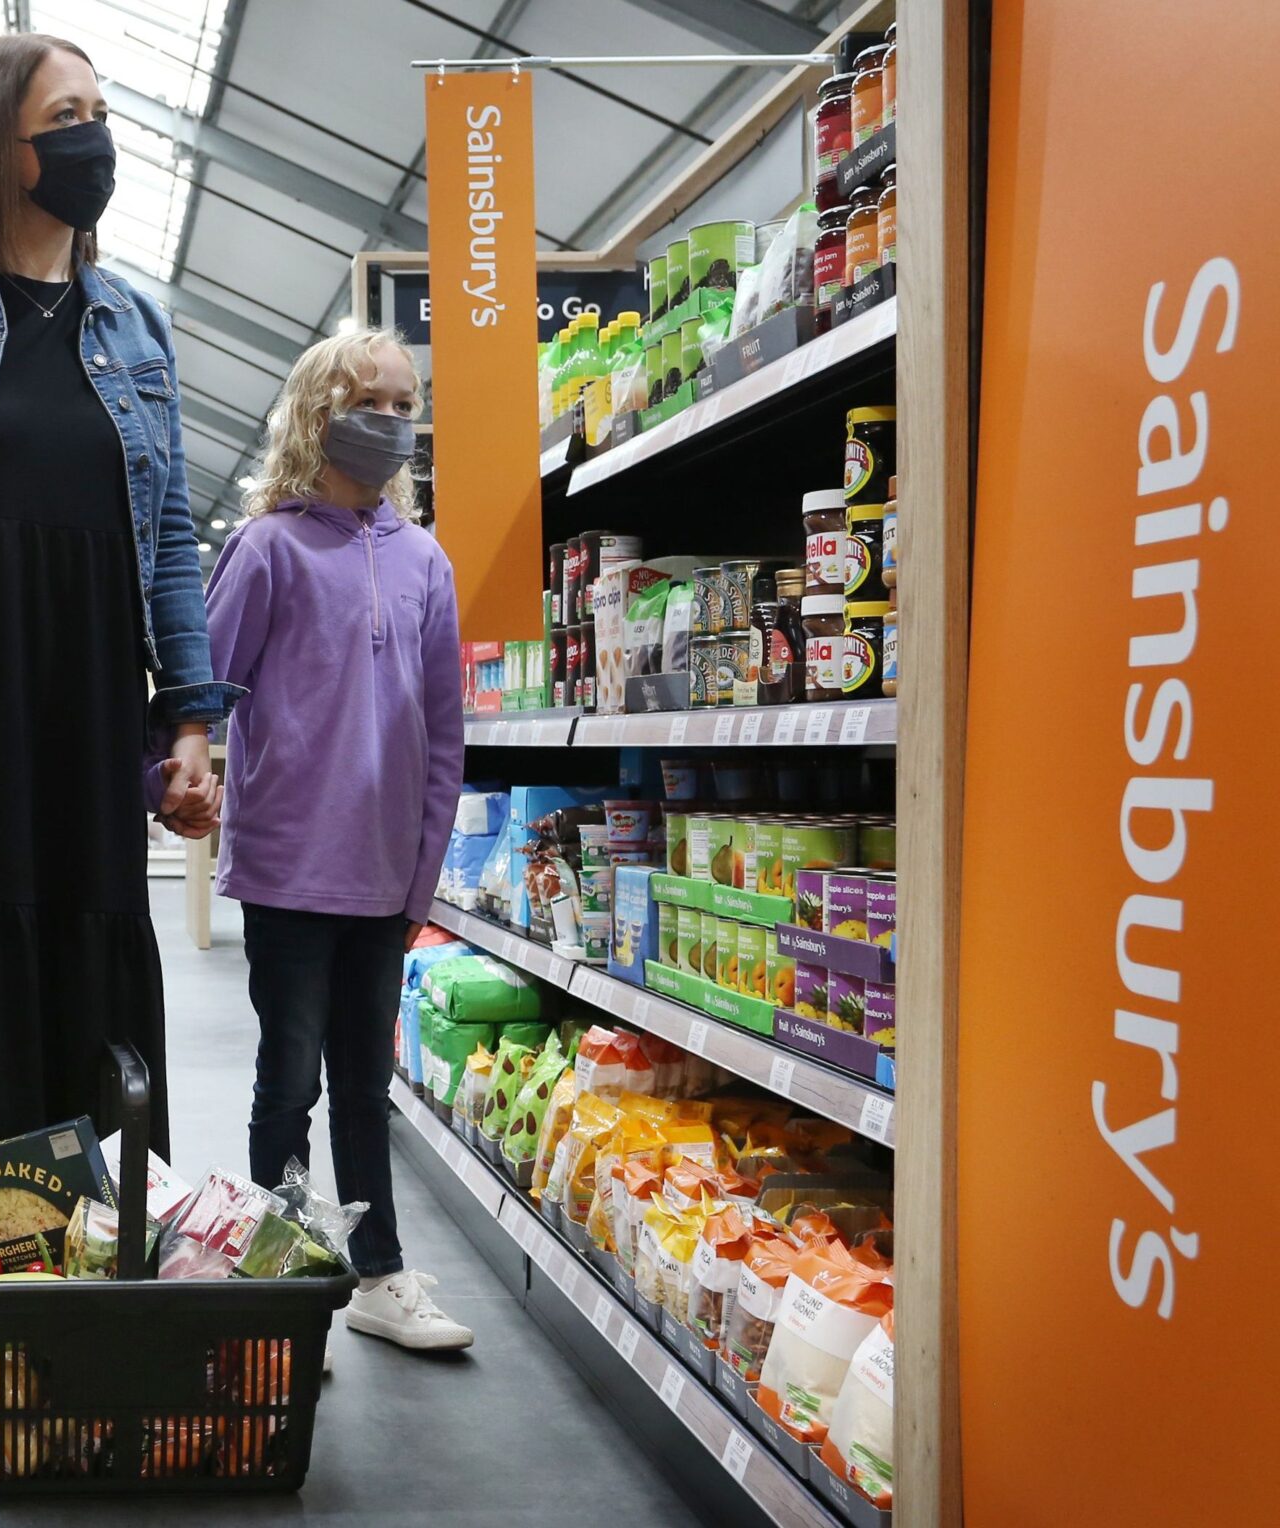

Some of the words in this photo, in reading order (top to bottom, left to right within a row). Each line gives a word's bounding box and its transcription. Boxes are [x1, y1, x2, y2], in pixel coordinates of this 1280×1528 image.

[858, 141, 888, 170] Sainsbury's
[462, 105, 506, 328] Sainsbury's
[852, 280, 880, 303] Sainsbury's
[562, 296, 602, 321] Go
[742, 338, 760, 359] FRUIT
[807, 536, 837, 558] tella
[728, 586, 744, 623] SYRUP
[1091, 257, 1240, 1320] Sainsbury's
[842, 885, 864, 895] slices
[796, 935, 827, 956] Sainsbury's
[794, 1023, 825, 1047] Sainsbury's
[722, 1370, 736, 1391] NUTS
[829, 1475, 848, 1501] NUTS
